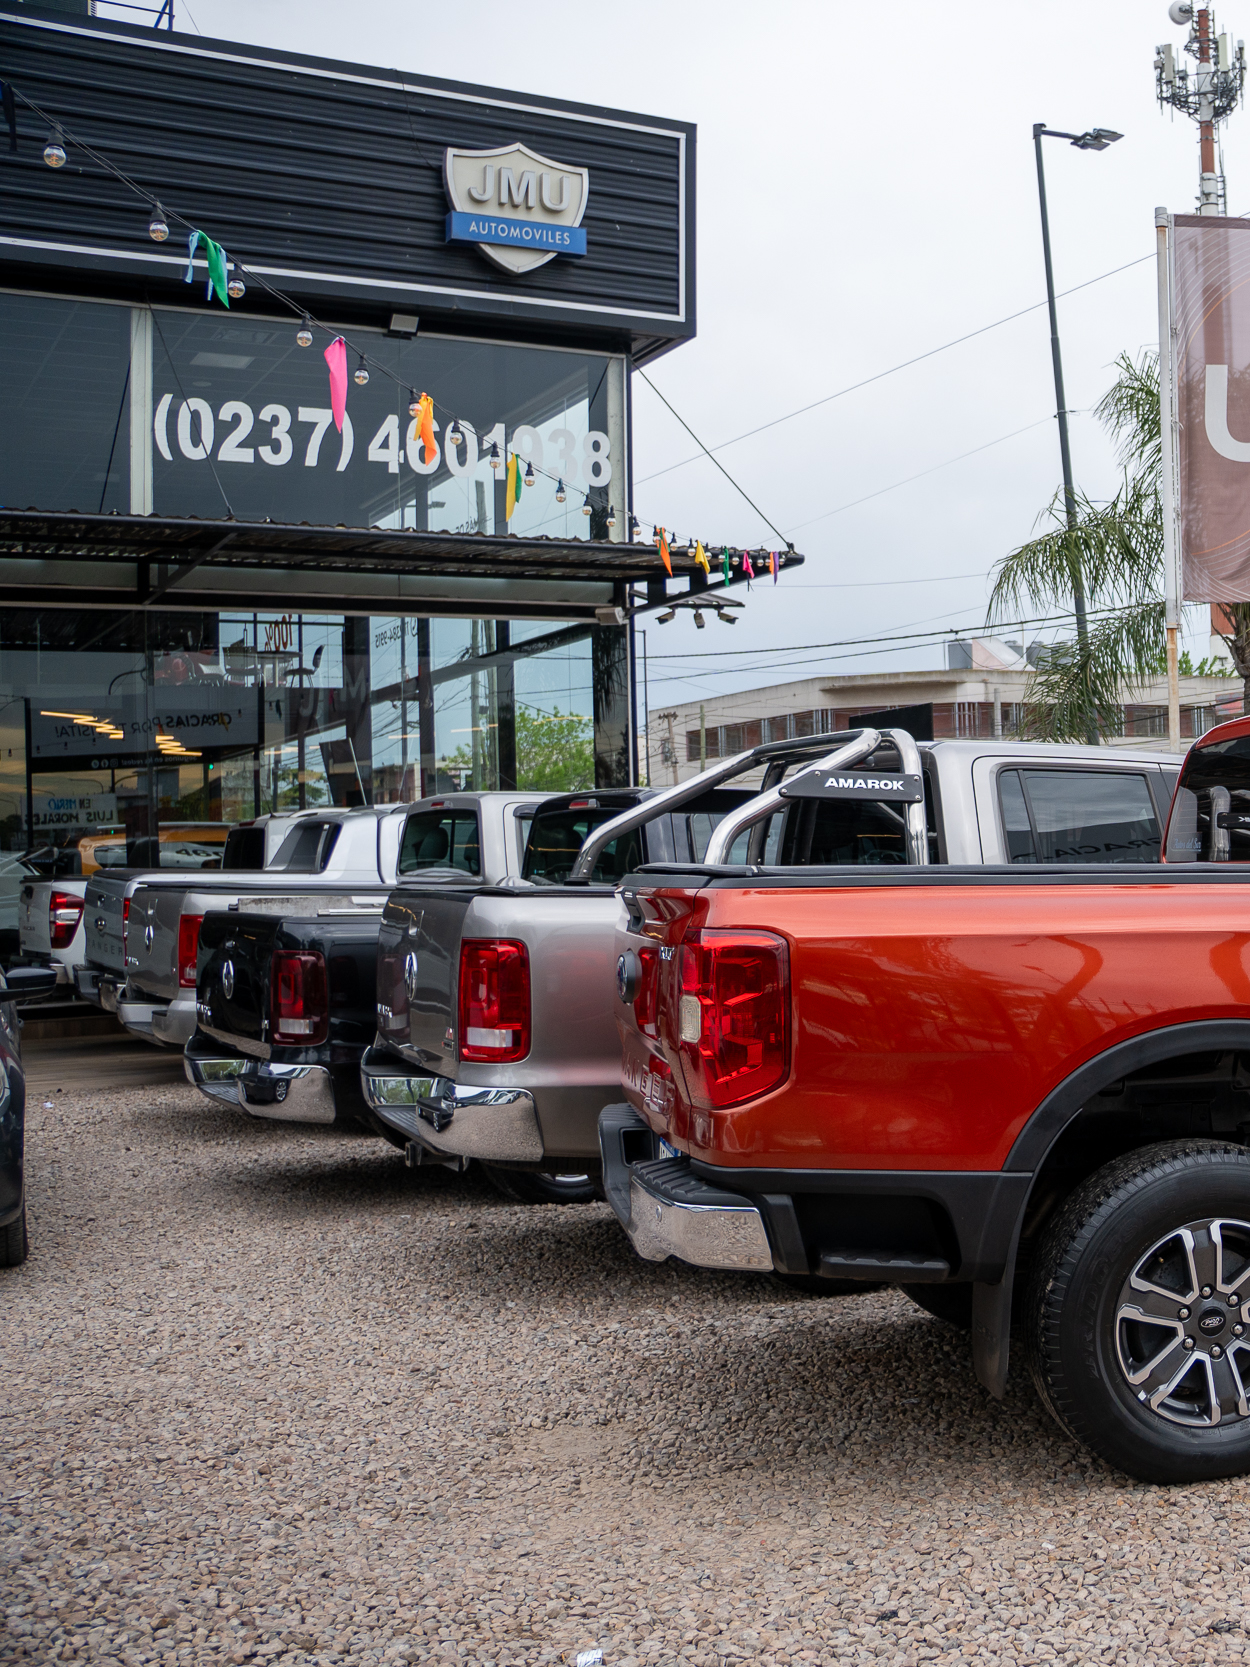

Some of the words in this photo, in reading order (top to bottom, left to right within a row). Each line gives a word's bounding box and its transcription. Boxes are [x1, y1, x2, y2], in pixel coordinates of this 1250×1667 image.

[468, 164, 571, 212] JMU
[469, 221, 571, 245] AUTOMOVILES
[154, 393, 354, 472] (0237)
[367, 413, 612, 487] 4601938
[824, 777, 905, 791] AMAROK
